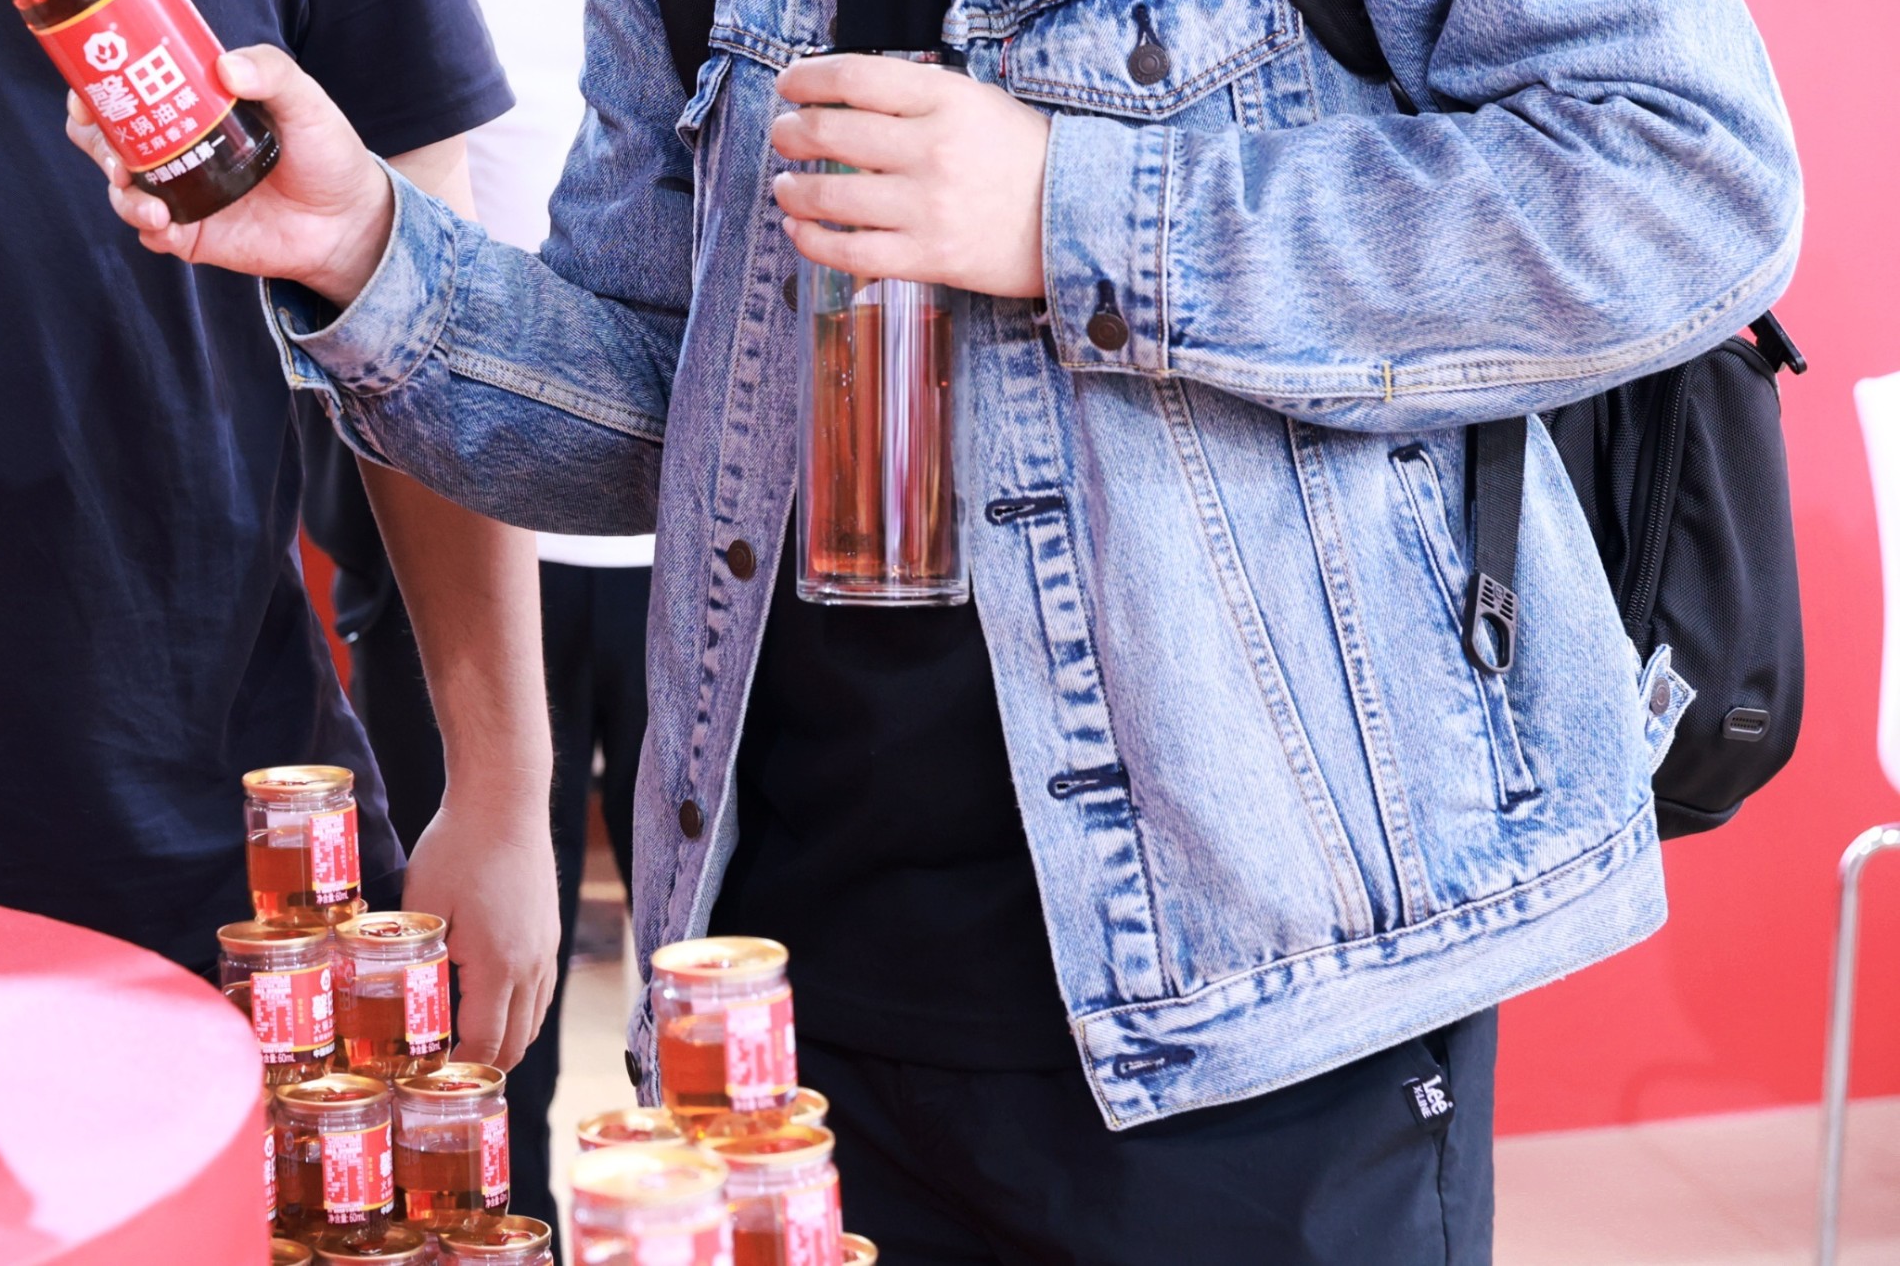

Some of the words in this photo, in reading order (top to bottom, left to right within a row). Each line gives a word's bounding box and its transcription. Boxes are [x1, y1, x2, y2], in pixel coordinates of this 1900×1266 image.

[84, 44, 187, 123] 馨田
[113, 85, 200, 144] 火锅油碟
[1422, 1074, 1448, 1115] Lee
